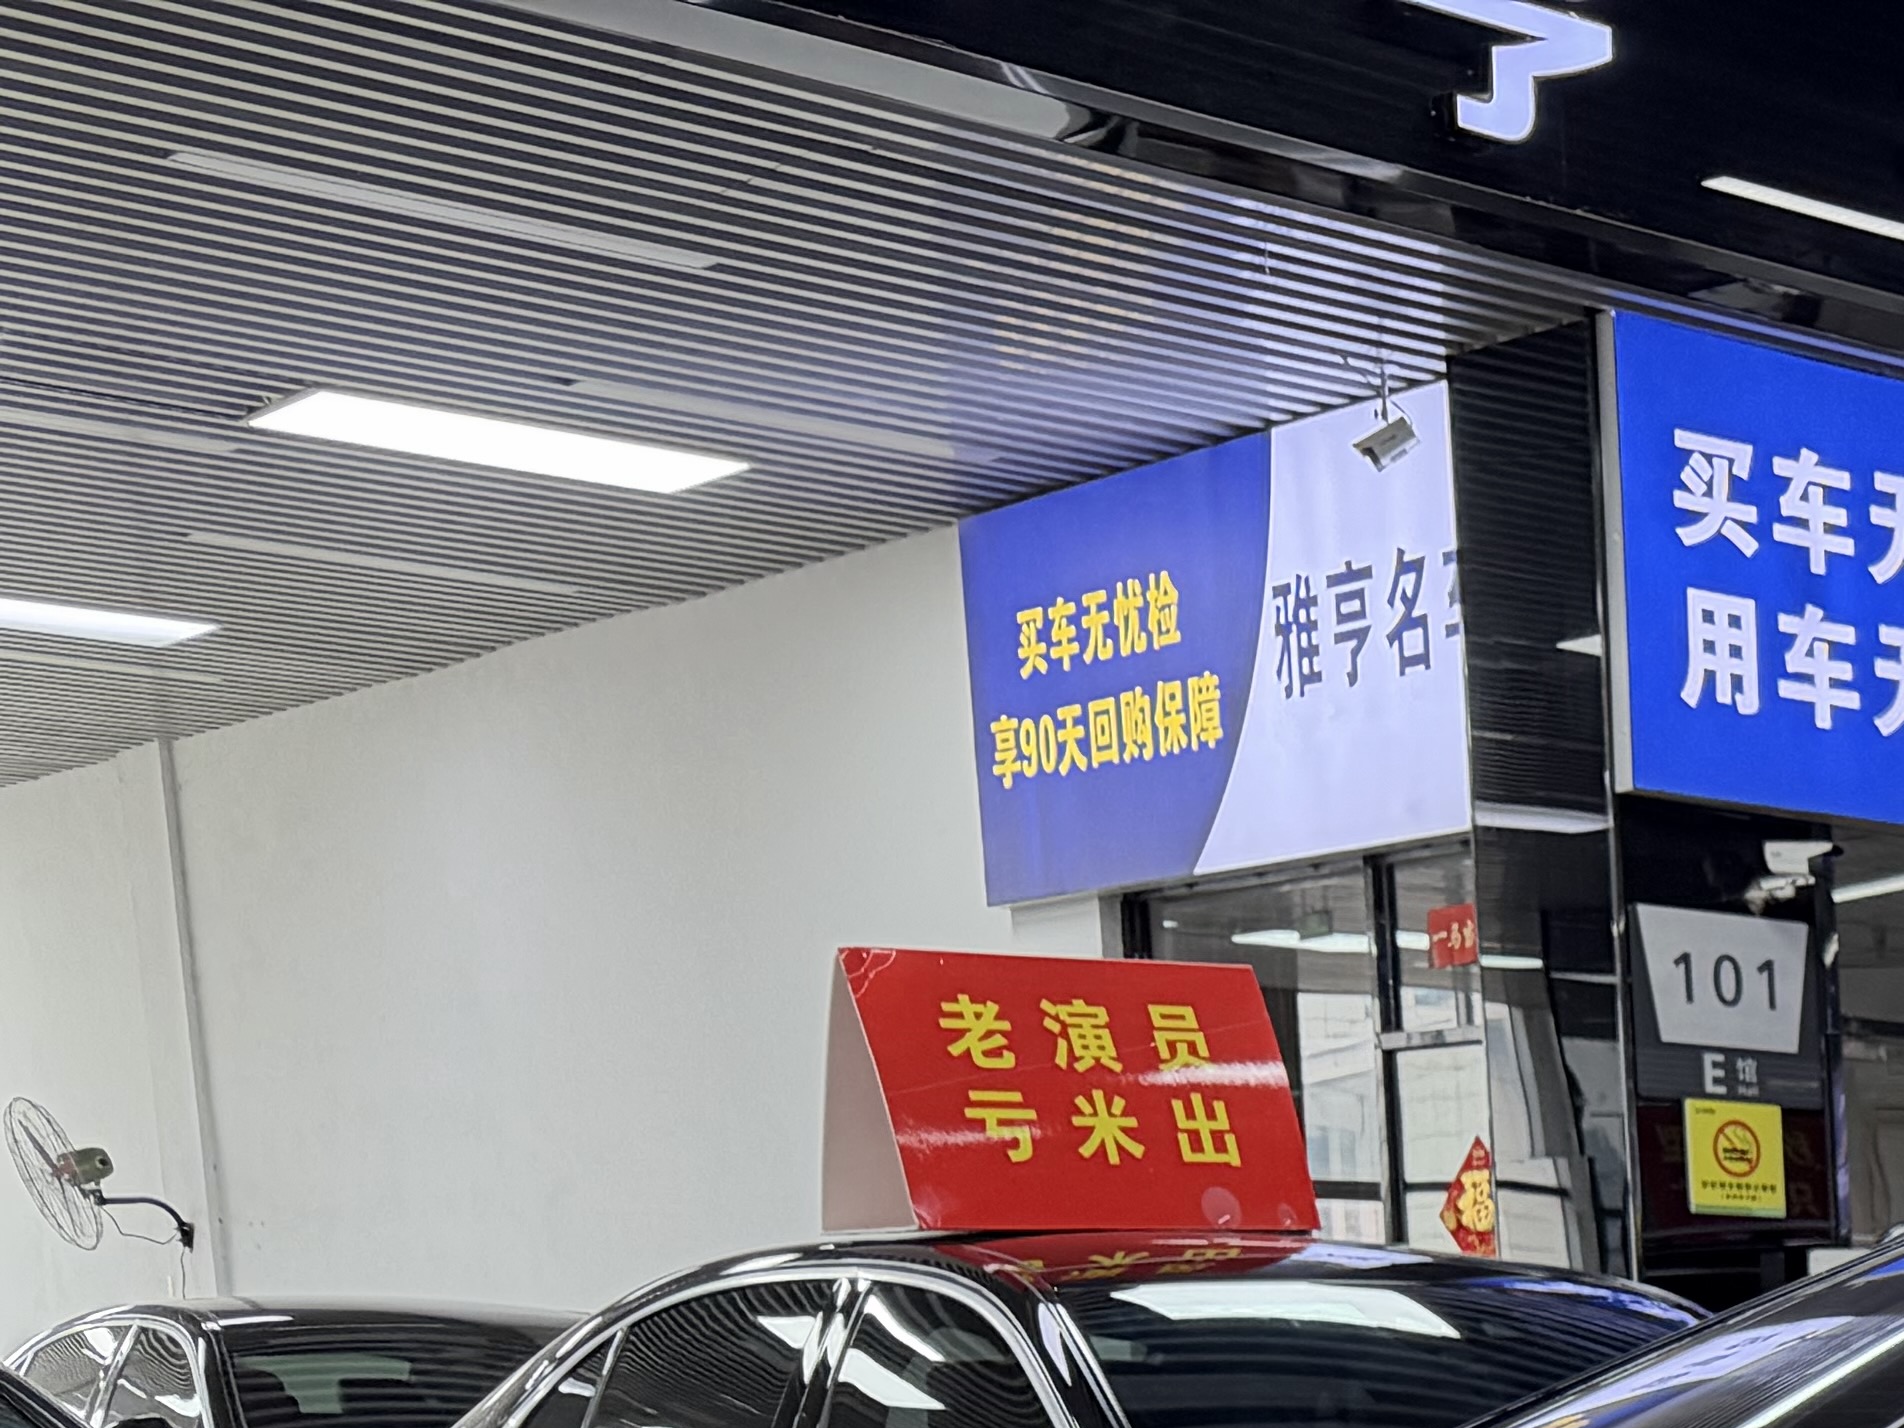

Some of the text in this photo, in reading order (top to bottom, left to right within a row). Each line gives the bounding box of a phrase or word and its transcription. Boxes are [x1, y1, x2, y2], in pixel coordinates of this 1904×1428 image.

[1016, 569, 1182, 681] 买车无忧检
[989, 669, 1224, 790] 享90天回购保障
[1673, 951, 1777, 1012] 101
[938, 993, 1211, 1073] 老演员
[1703, 1052, 1728, 1095] E
[963, 1088, 1242, 1168] 亏米出
